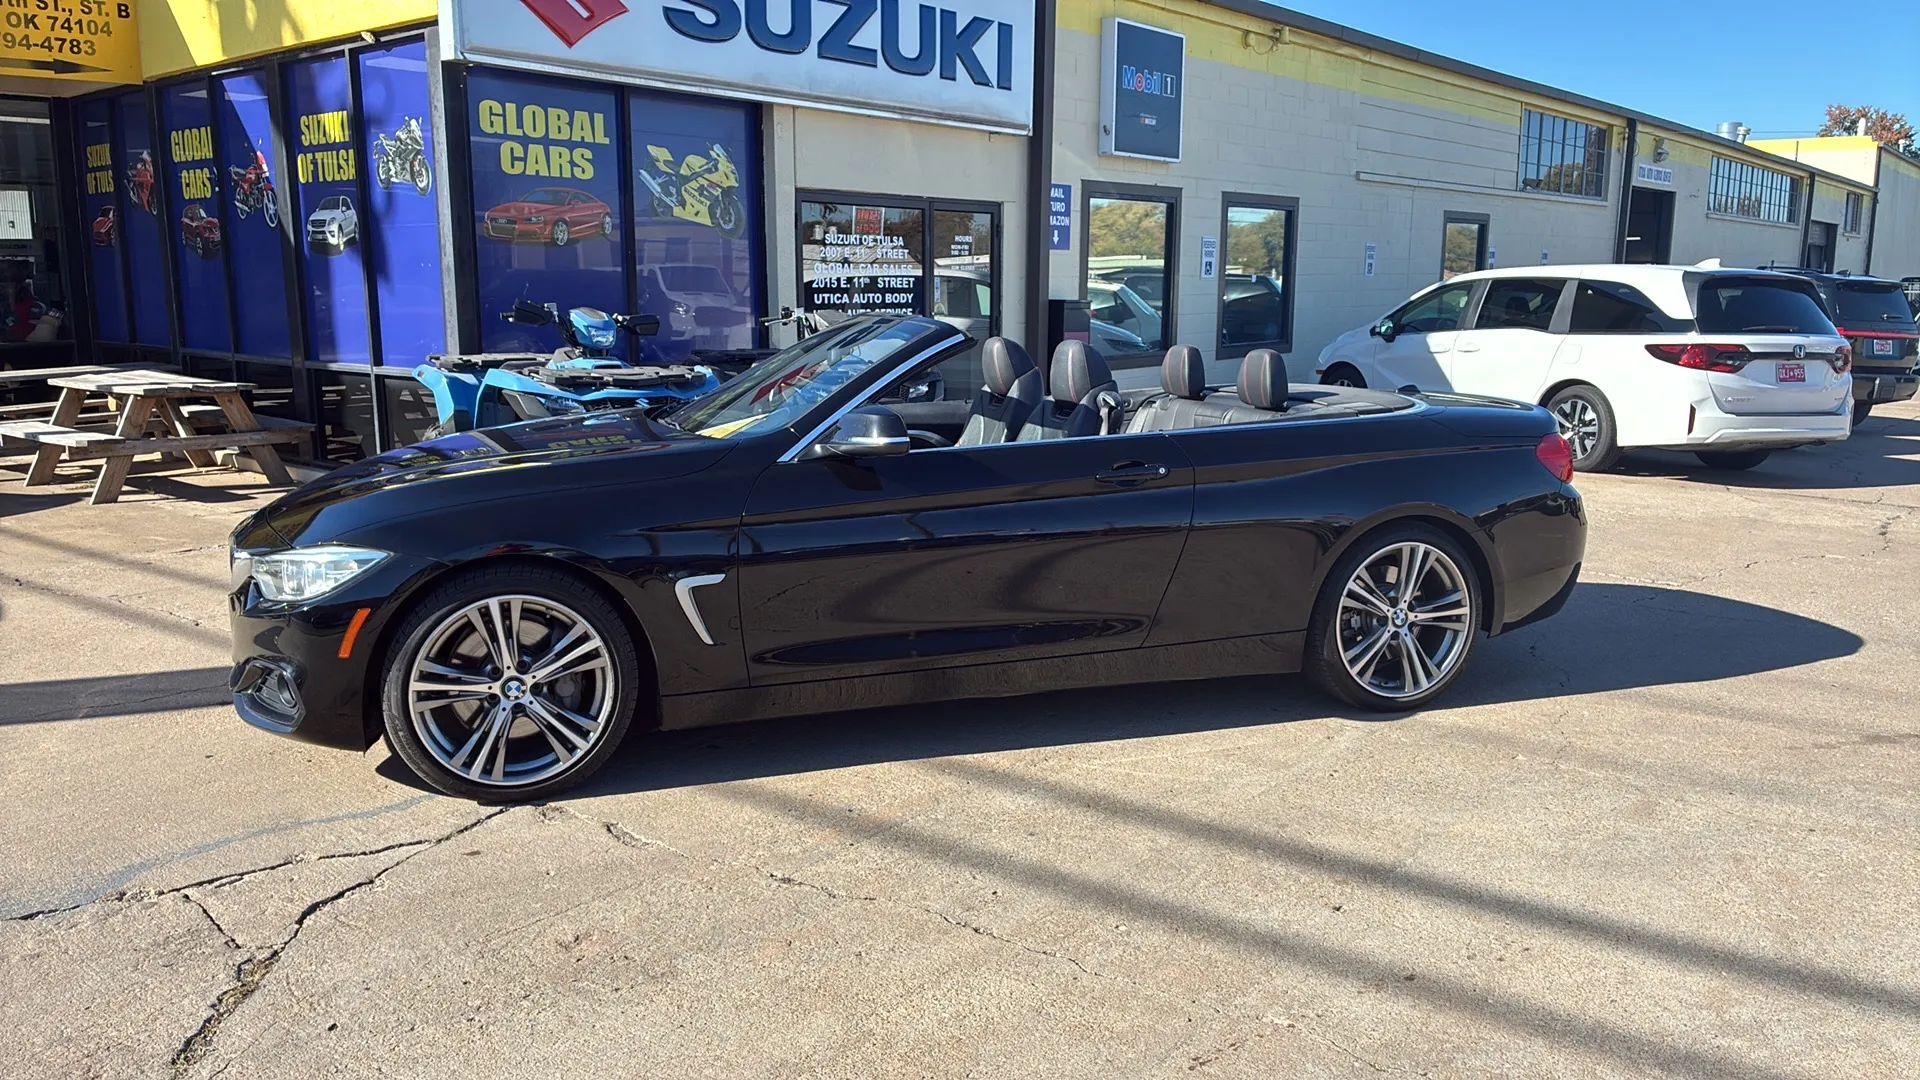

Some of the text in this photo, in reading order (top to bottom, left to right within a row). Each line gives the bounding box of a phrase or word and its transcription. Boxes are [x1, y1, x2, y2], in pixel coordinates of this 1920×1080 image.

[6, 11, 113, 37] OK 74104
[117, 3, 131, 19] B
[0, 31, 97, 57] 94-4783
[662, 0, 1014, 92] SUZUKI
[1123, 65, 1161, 95] Mobil
[300, 110, 349, 147] SUZUKI
[479, 99, 610, 145] GLOBAL
[297, 149, 356, 184] OF TULSA
[500, 141, 594, 180] CARS
[181, 167, 212, 200] CARS
[819, 246, 841, 258] 2007
[844, 247, 854, 258] E.
[876, 248, 910, 260] STREET
[824, 234, 905, 247] SUZUKI OF TULSA
[811, 276, 839, 289] 2015
[840, 277, 851, 289] E.
[876, 277, 916, 289] STREET
[813, 263, 914, 276] GLOBAL CAR SALES
[813, 293, 915, 305] UTICA AUTO BODY
